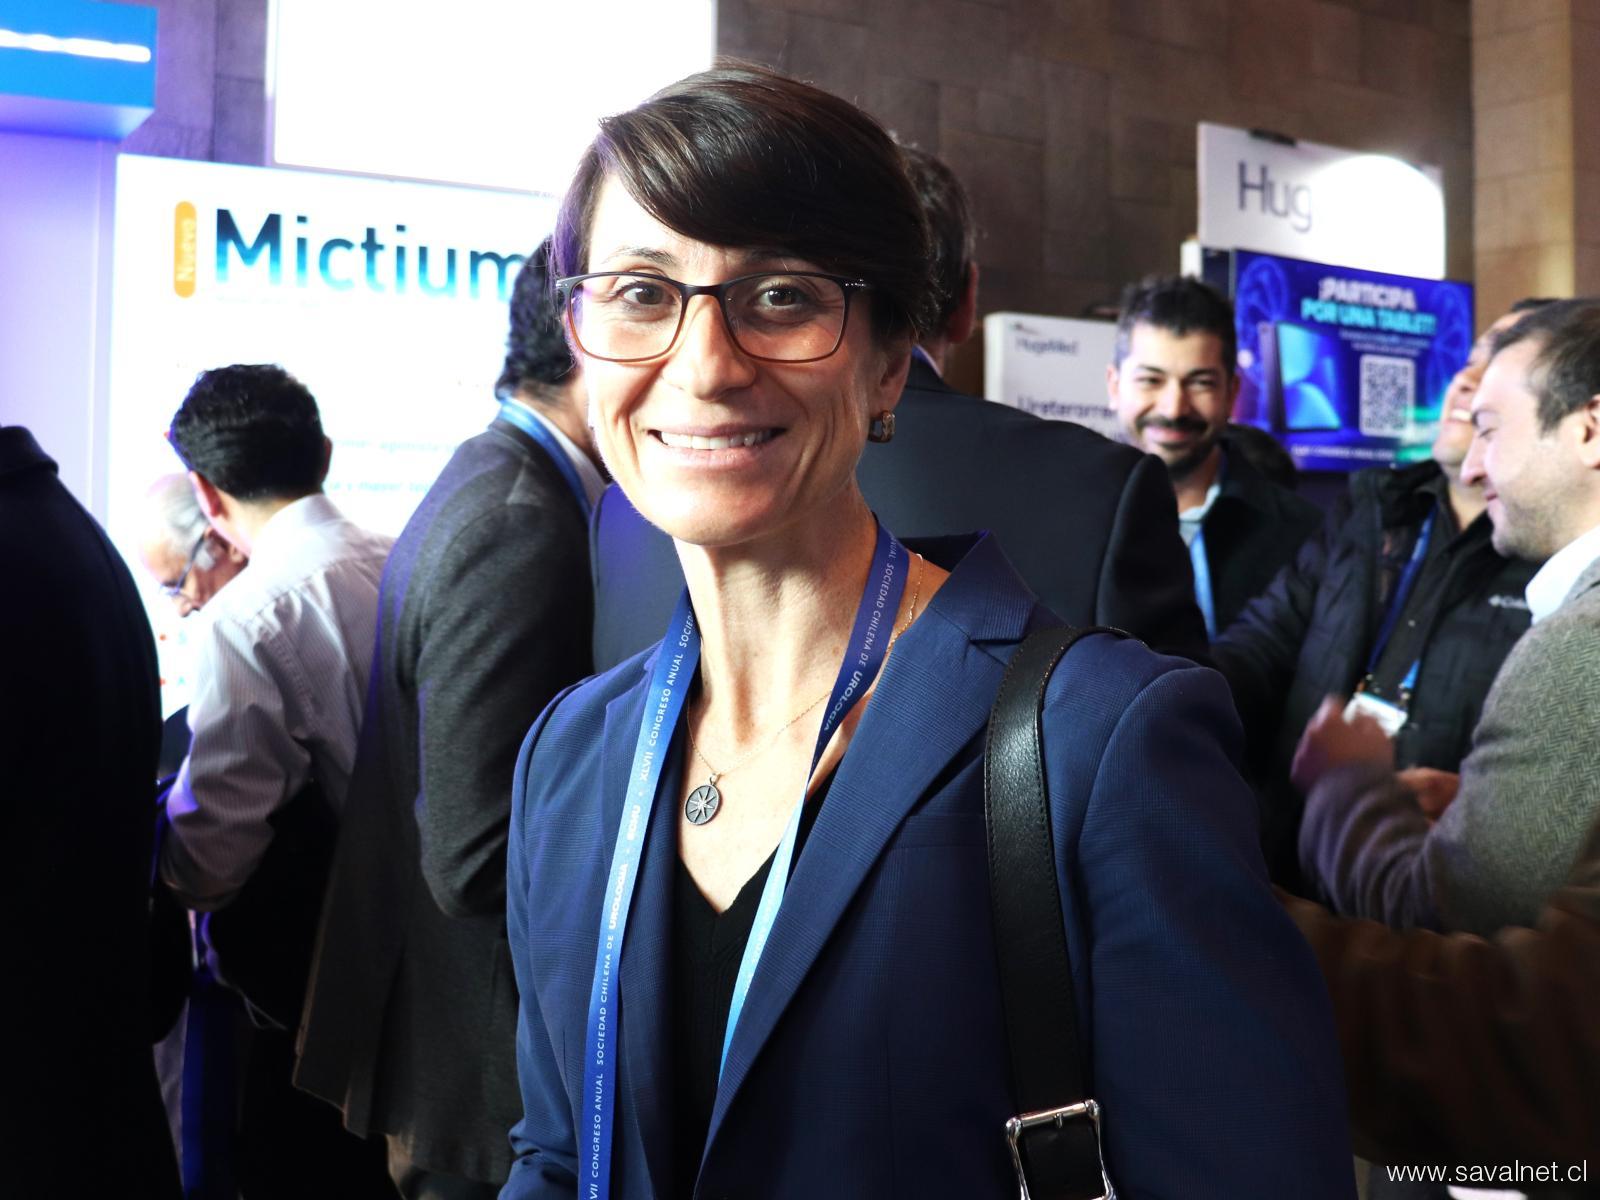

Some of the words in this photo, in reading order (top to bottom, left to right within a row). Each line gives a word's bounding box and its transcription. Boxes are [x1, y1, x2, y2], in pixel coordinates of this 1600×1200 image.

[215, 208, 527, 303] Mictium
[876, 562, 894, 609] SOCIEDAD
[863, 609, 882, 651] CHILENA
[668, 653, 684, 687] ANUAL
[860, 652, 871, 667] DE
[649, 687, 672, 747] CONGRESO
[640, 751, 654, 782] XLVII
[606, 935, 614, 949] DE
[600, 953, 611, 1003] CHILENA
[596, 1007, 607, 1066] SOCIEDAD
[594, 1073, 604, 1111] ANUAL
[591, 1114, 602, 1178] CONGRESO
